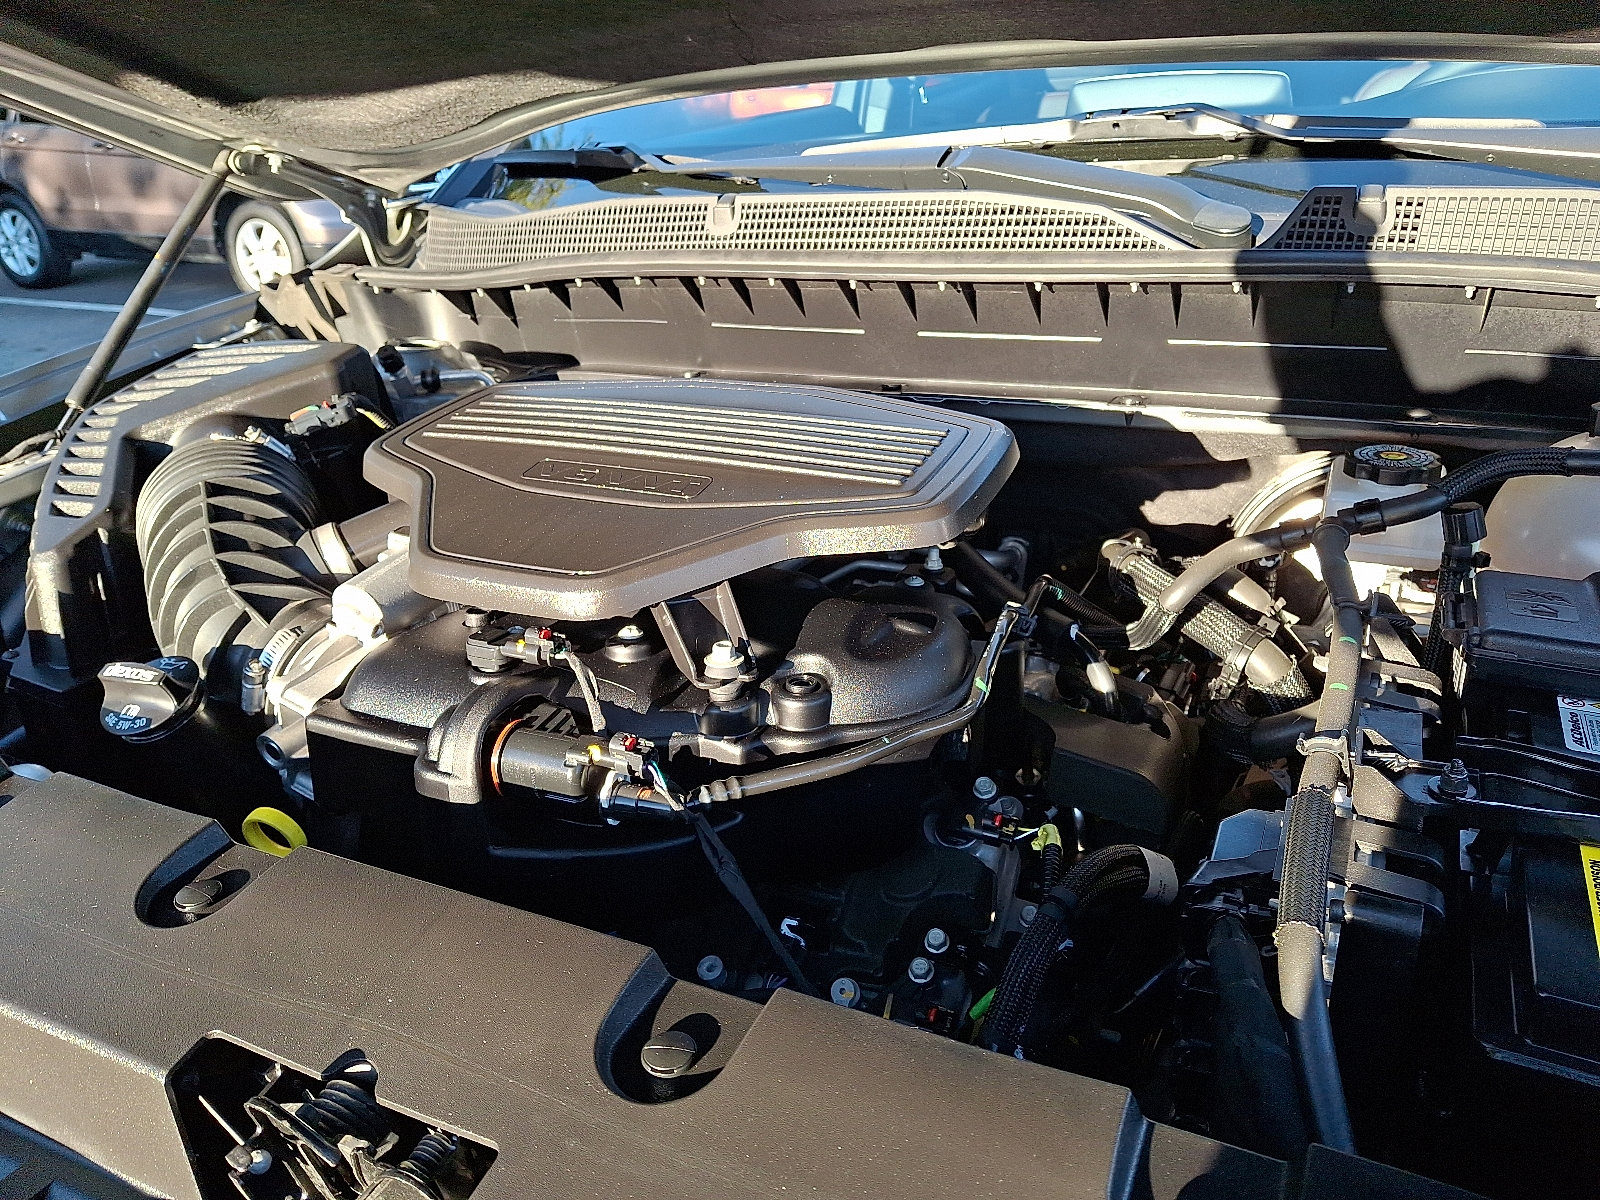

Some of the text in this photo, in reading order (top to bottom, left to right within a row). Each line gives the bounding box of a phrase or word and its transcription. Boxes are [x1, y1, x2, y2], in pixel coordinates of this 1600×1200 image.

[103, 663, 159, 682] dexos
[105, 712, 147, 730] SAE 5W-30
[1568, 711, 1586, 748] ACDelco
